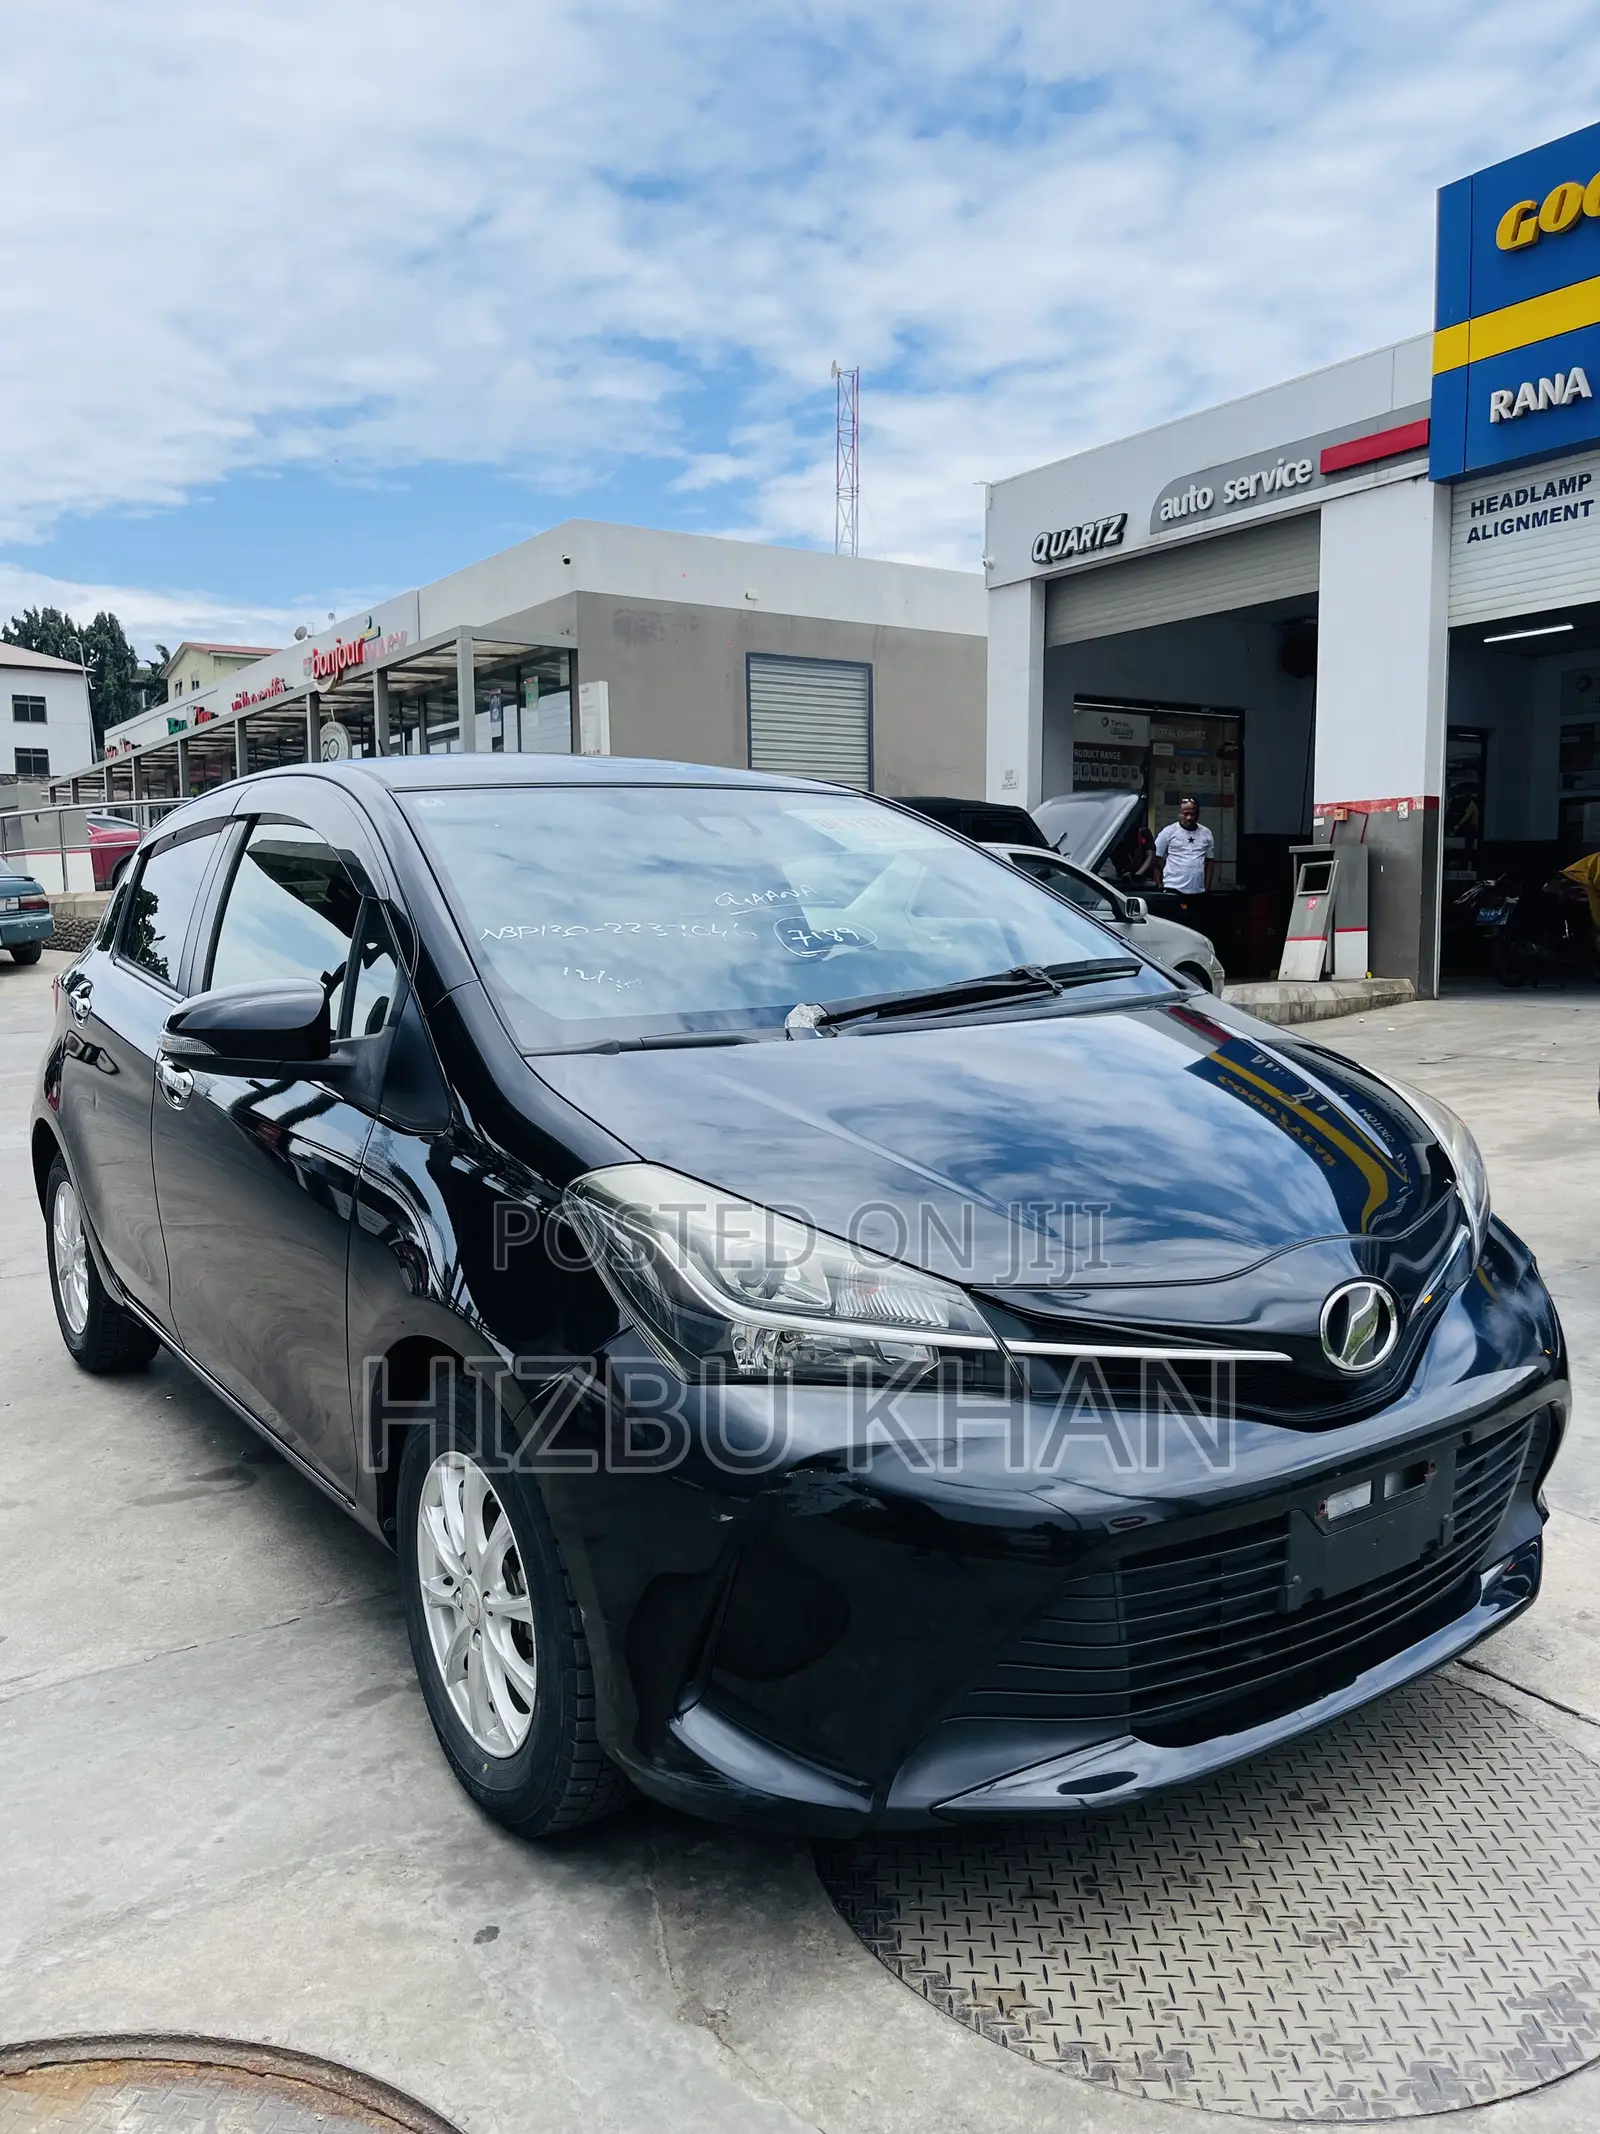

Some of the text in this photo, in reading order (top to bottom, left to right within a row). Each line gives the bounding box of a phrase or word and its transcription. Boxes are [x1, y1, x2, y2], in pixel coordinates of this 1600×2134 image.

[1490, 367, 1592, 423] RANA
[1160, 458, 1313, 521] auto service
[1471, 473, 1592, 518] HEADLAMP
[1031, 513, 1128, 563] QUARTZ
[1467, 500, 1594, 543] ALIGNMENT
[312, 637, 366, 680] bonjour
[1073, 748, 1121, 761] RODUCT RANGE
[1177, 729, 1207, 740] QUARTZ
[788, 927, 860, 949] 7189
